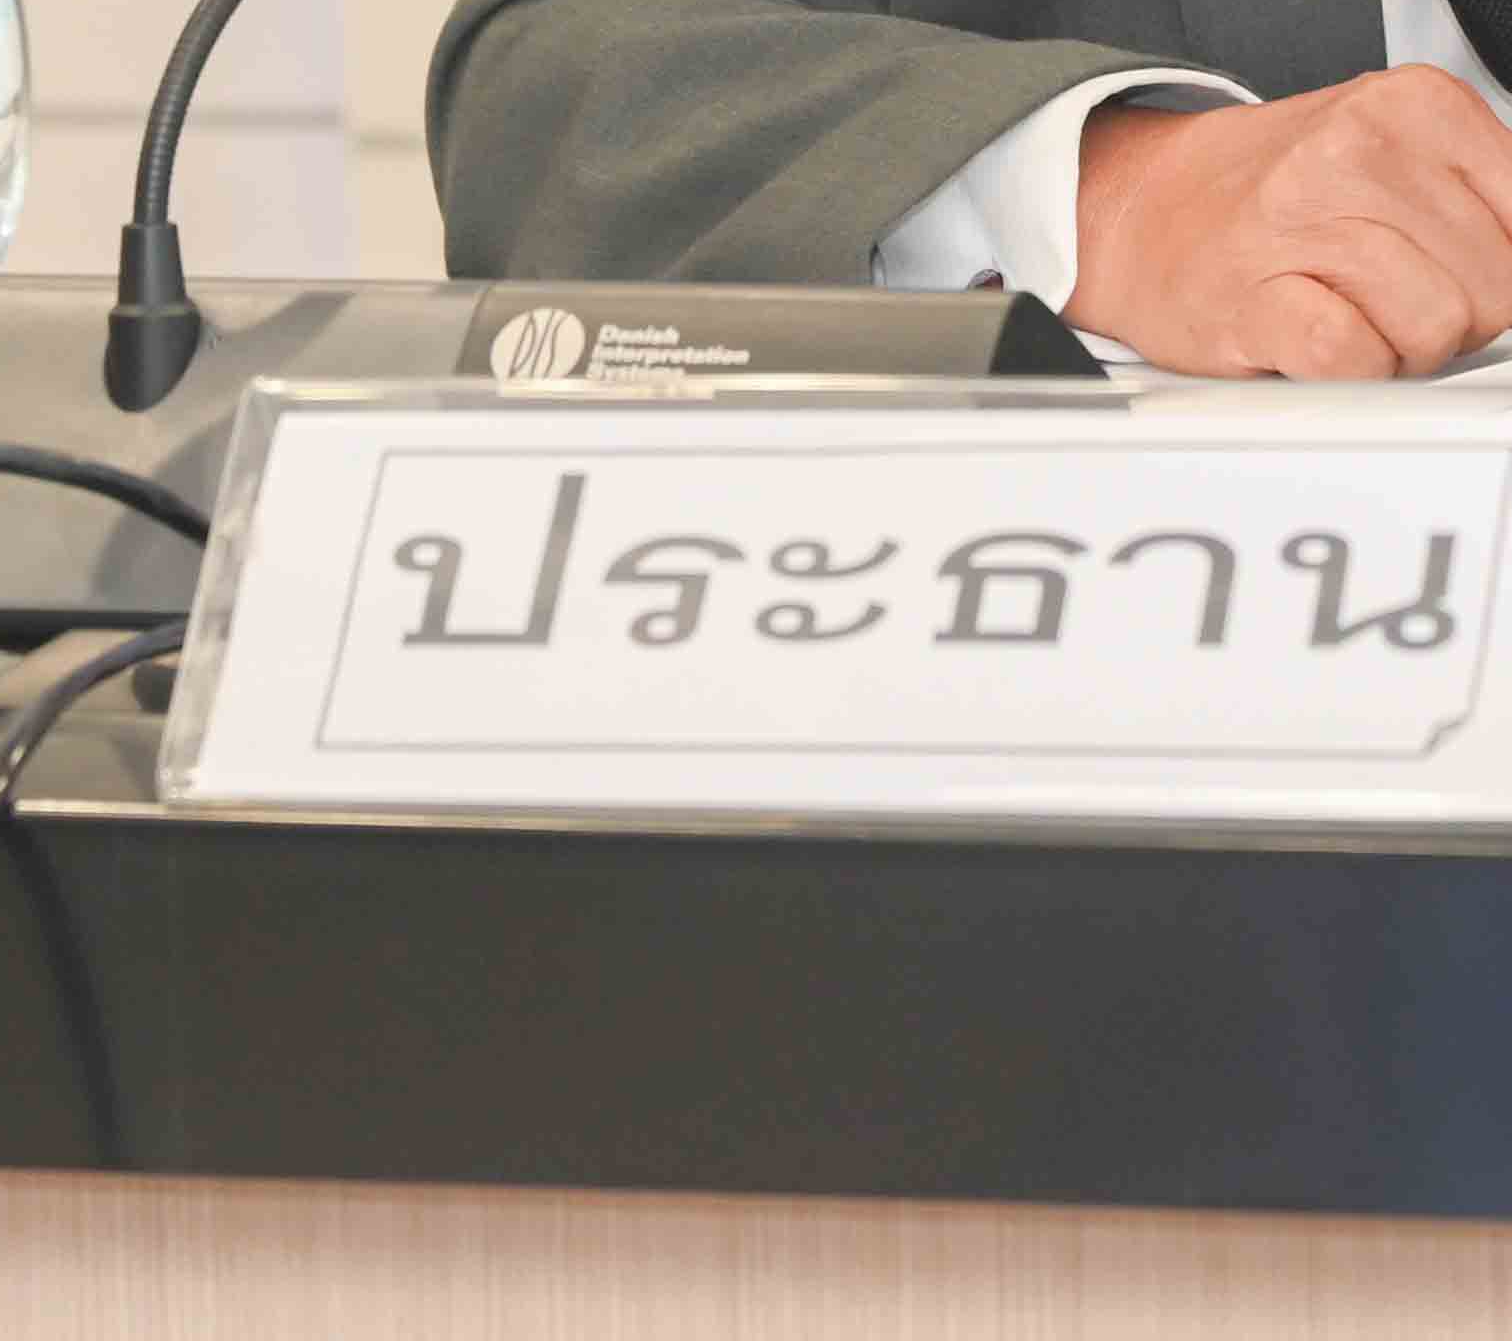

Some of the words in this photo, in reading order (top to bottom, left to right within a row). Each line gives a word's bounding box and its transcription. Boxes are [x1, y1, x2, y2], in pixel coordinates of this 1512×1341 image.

[598, 324, 679, 345] Danish
[393, 473, 1458, 651] ประธาน
